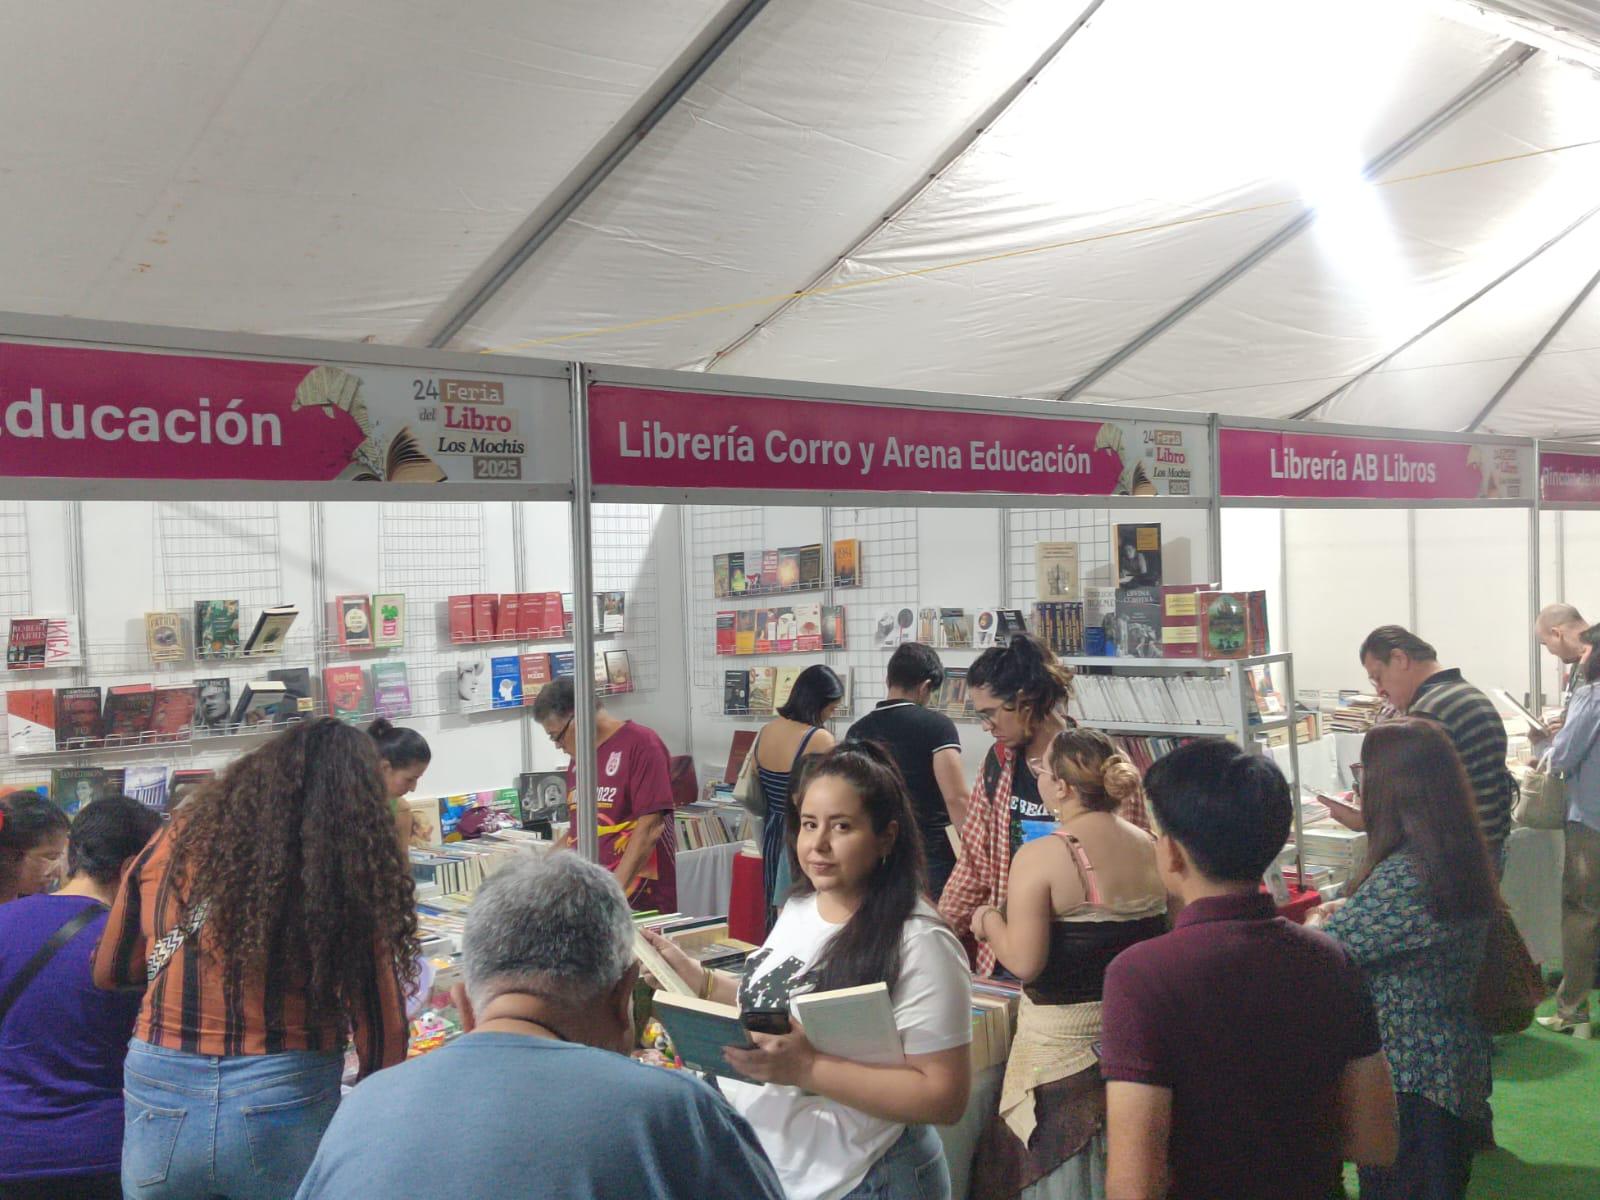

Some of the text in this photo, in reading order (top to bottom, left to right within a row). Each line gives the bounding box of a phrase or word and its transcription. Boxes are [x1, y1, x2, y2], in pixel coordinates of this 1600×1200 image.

[413, 379, 501, 402] 24 Feria
[0, 387, 283, 447] ducación
[419, 405, 512, 433] del Libro
[437, 436, 526, 455] Los Mochis
[618, 419, 1092, 476] Librería Corro y Arena Educación
[1155, 447, 1186, 464] Libro
[477, 459, 519, 478] 2025
[1270, 448, 1436, 484] Librería AB Libros
